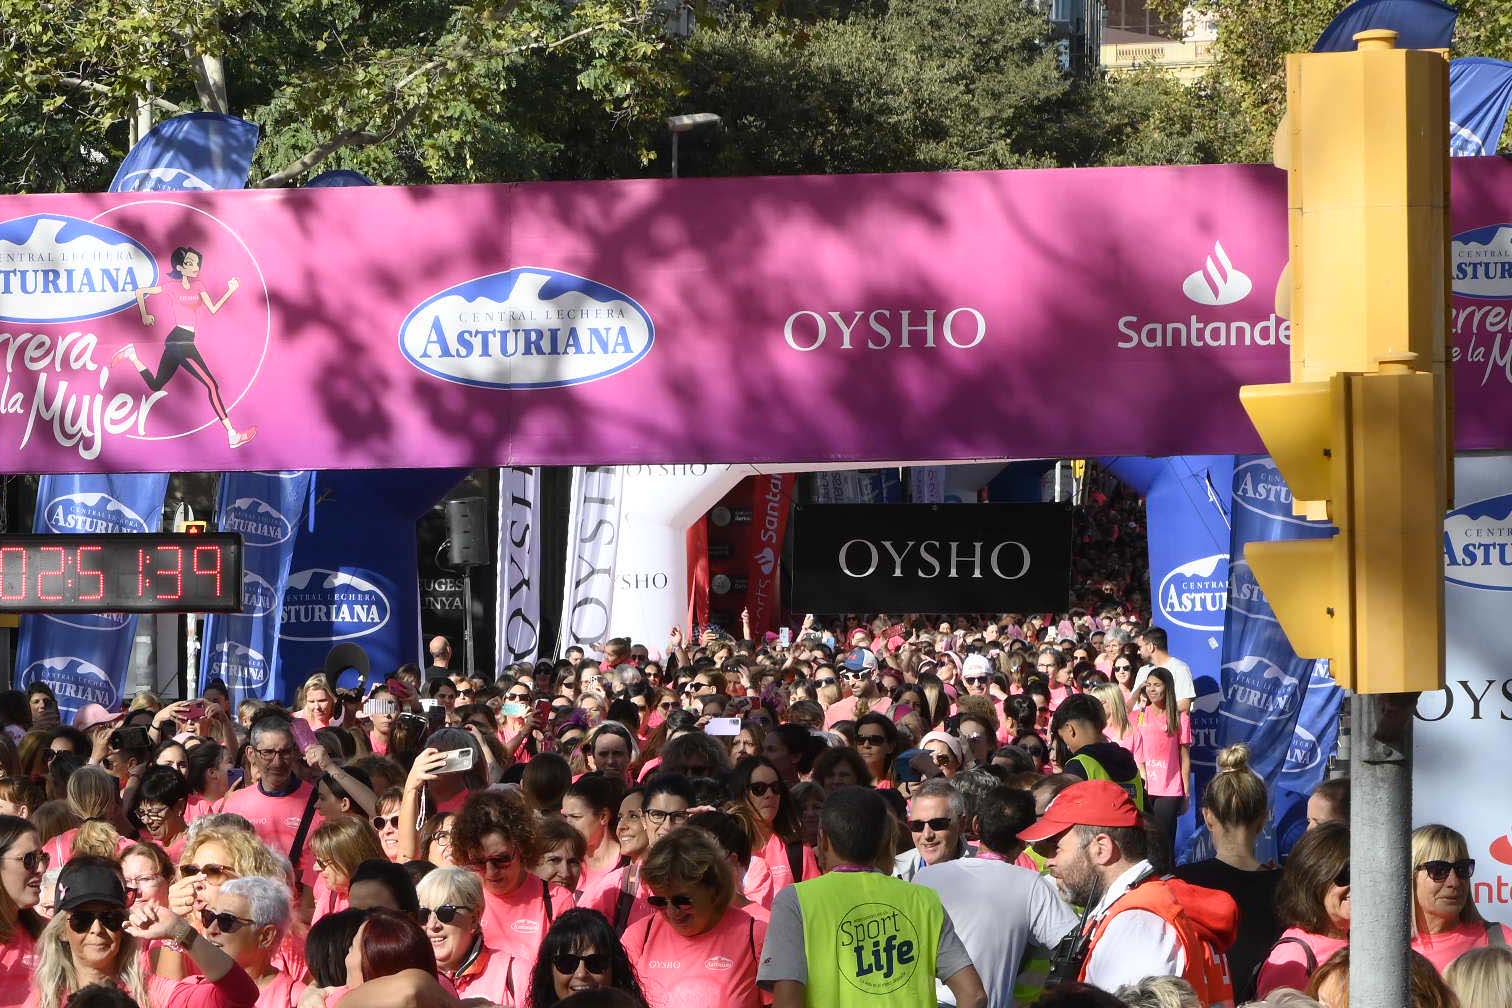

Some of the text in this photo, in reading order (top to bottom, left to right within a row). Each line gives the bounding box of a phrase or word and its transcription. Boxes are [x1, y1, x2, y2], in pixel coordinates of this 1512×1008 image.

[60, 251, 134, 263] LECHERA
[1457, 250, 1510, 258] CENTRAL
[458, 308, 626, 323] CENTRAL LECHERA
[783, 306, 987, 352] OYSHO
[1117, 313, 1291, 349] Santande
[419, 315, 635, 359] ASTURIANA
[1467, 334, 1485, 362] la
[1481, 332, 1512, 386] M
[0, 374, 25, 414] la
[19, 366, 169, 460] Mujer
[51, 504, 139, 534] ASTURIA
[838, 538, 1032, 580] OYSHO
[326, 592, 377, 602] LECHERA
[617, 571, 669, 590] SHO
[281, 604, 381, 624] STURIANA
[29, 670, 110, 707] ATURIANA
[840, 910, 901, 948] Sport
[853, 934, 915, 979] Life
